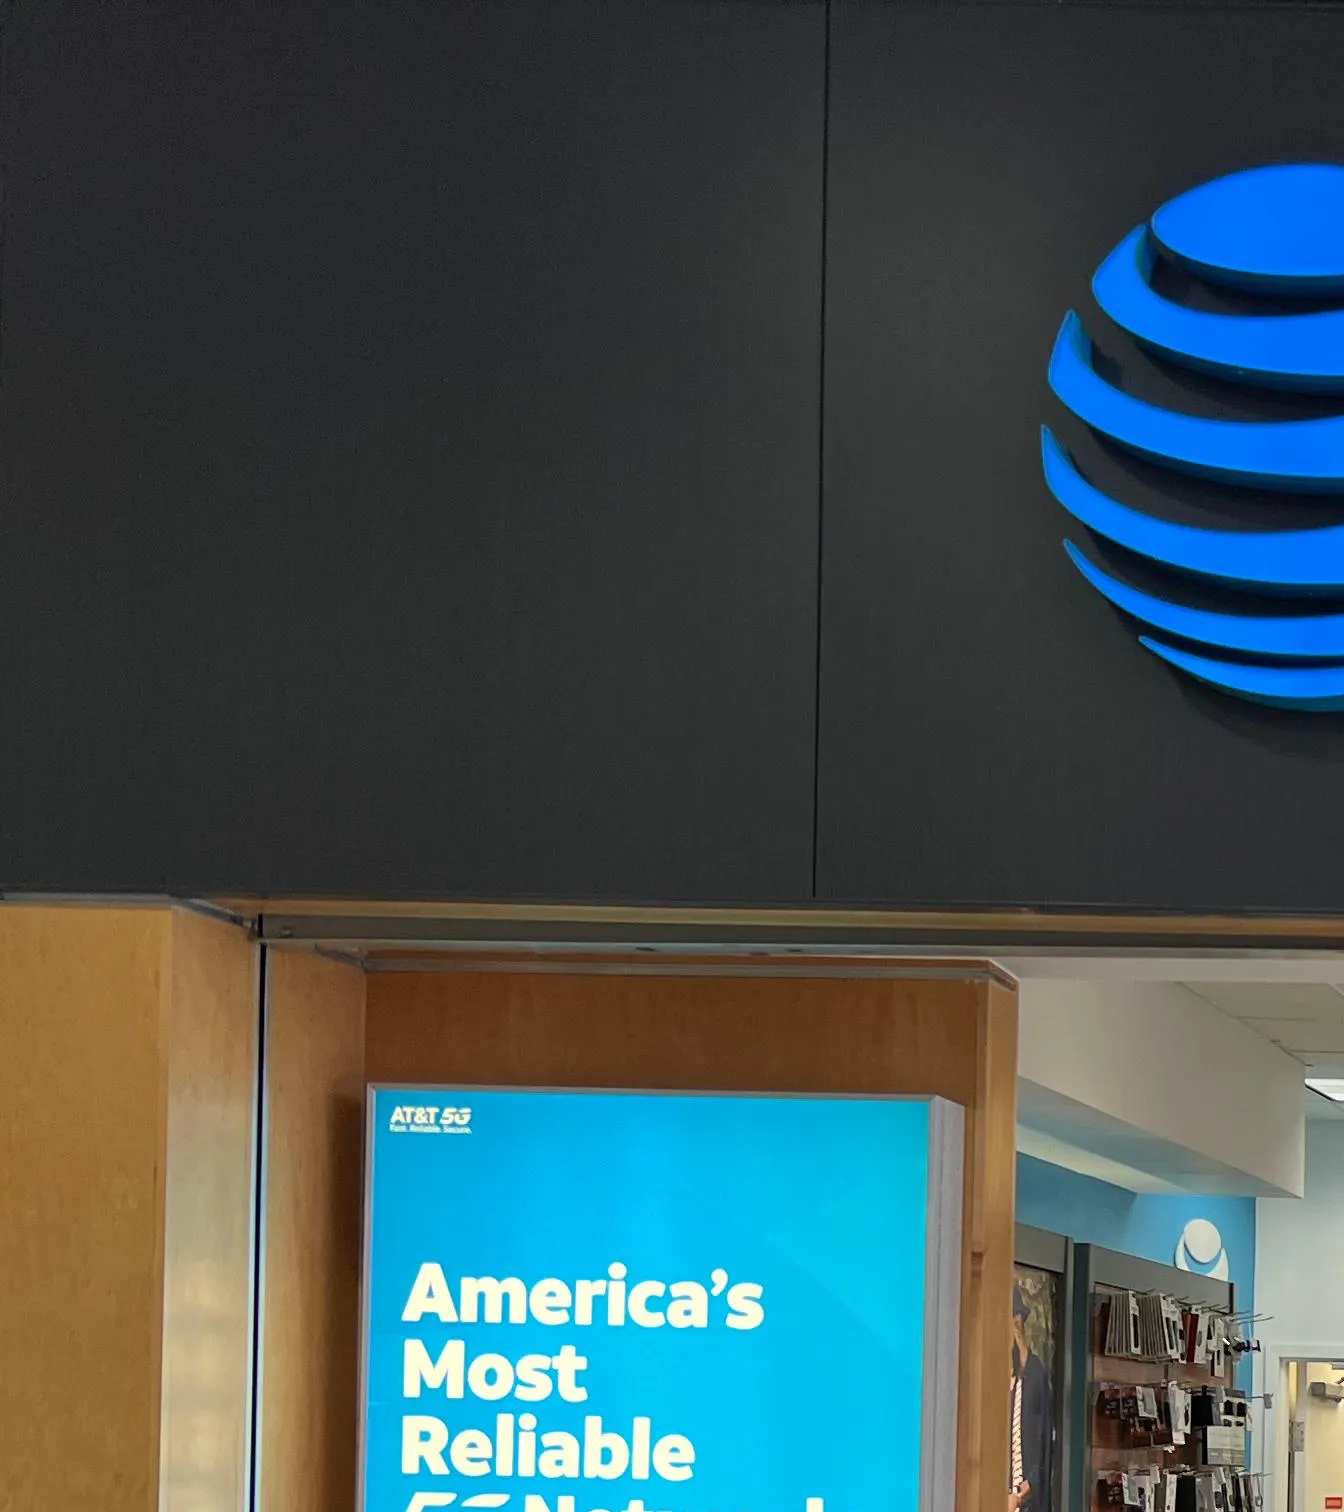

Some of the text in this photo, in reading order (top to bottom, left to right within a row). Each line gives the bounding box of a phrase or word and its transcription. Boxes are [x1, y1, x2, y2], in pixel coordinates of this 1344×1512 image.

[389, 1105, 472, 1125] AT&T 5G
[401, 1262, 765, 1330] America's
[402, 1340, 588, 1402] Most
[401, 1414, 696, 1480] Reliable
